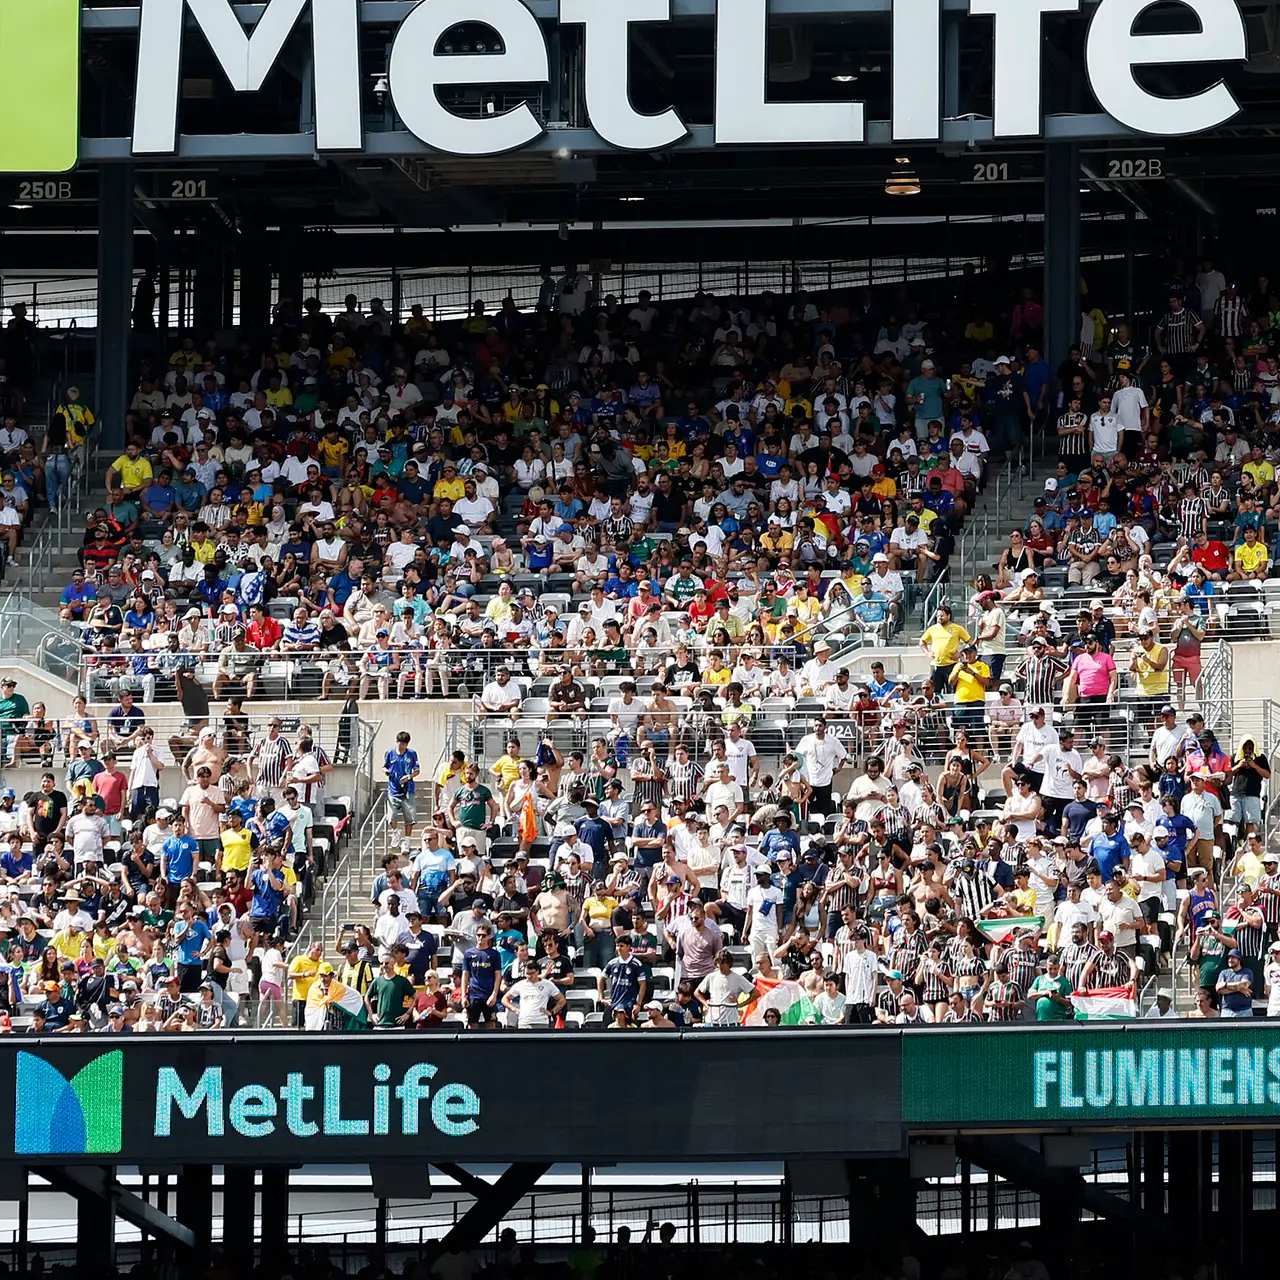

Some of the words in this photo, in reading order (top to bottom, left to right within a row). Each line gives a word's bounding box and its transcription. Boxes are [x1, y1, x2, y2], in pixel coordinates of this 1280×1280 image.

[973, 164, 1008, 181] 201
[1108, 160, 1162, 178] 202B
[19, 182, 72, 200] 250B
[171, 180, 207, 198] 201
[828, 724, 854, 739] 02A
[154, 1062, 482, 1139] MetLife
